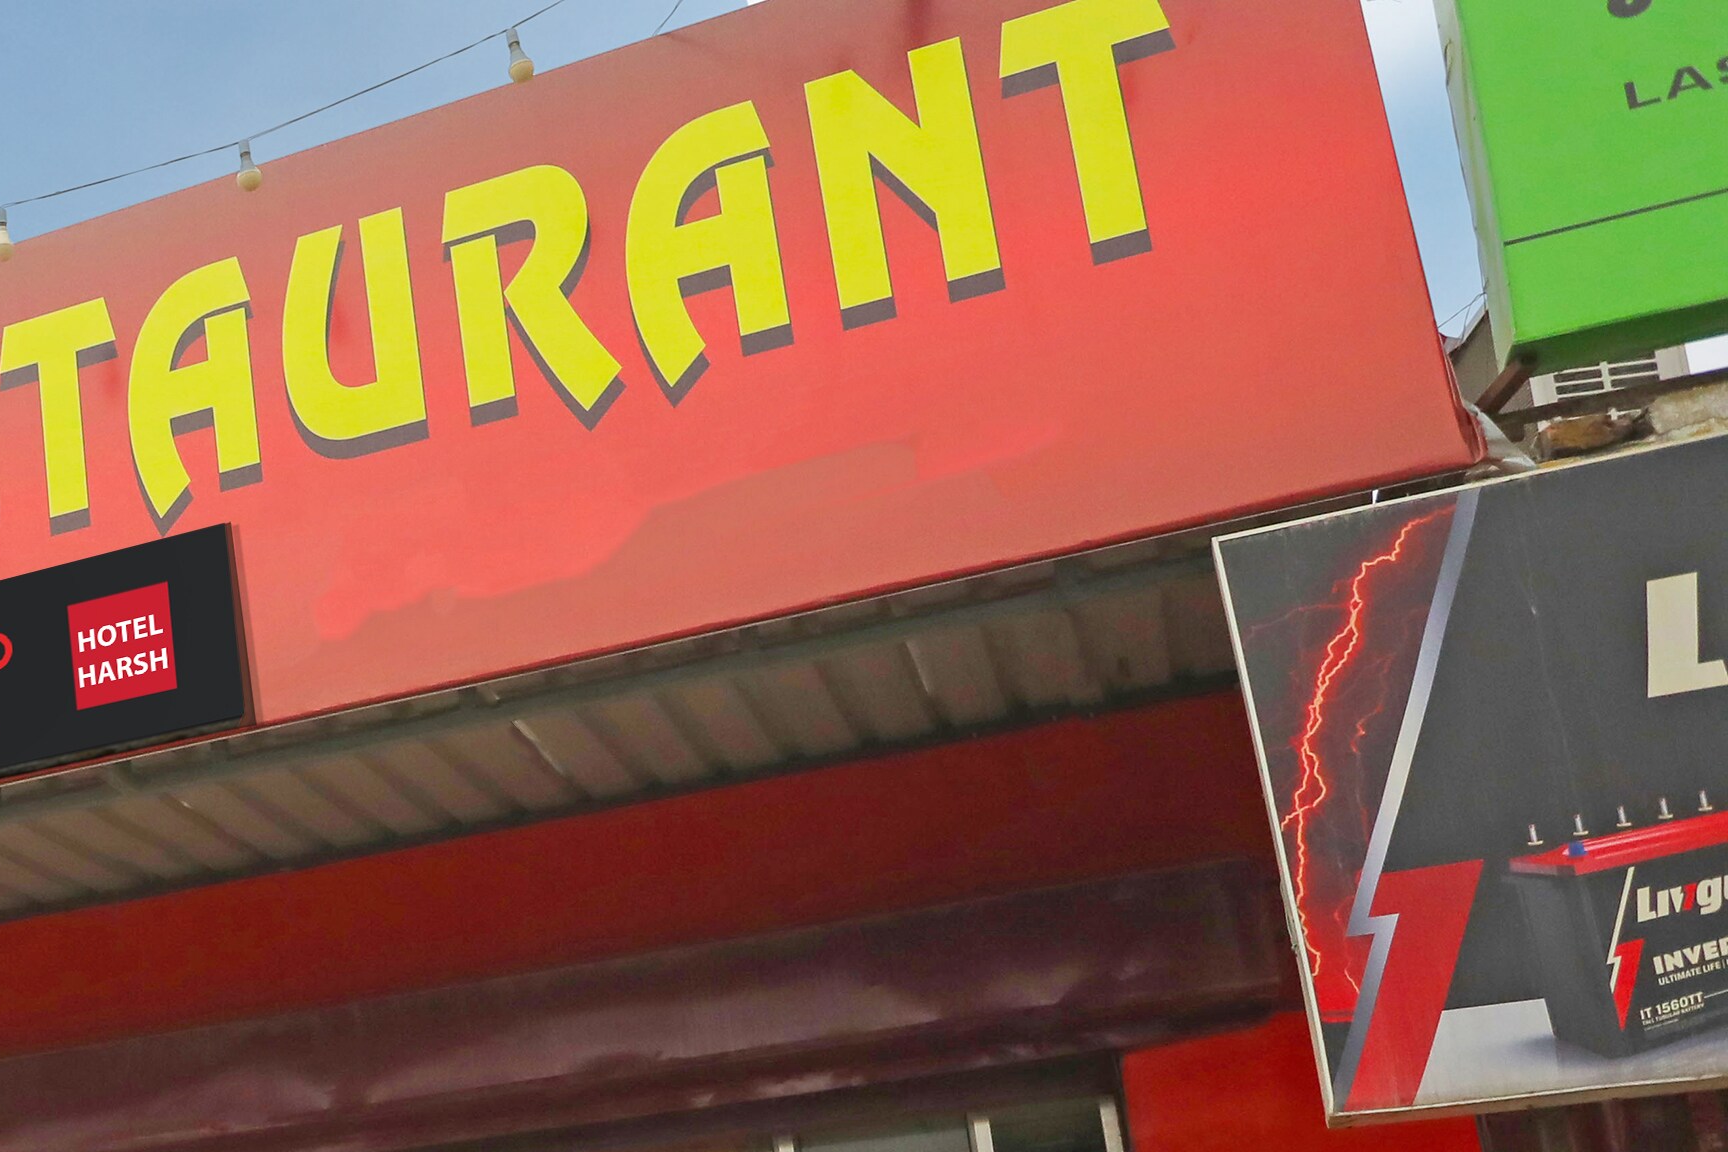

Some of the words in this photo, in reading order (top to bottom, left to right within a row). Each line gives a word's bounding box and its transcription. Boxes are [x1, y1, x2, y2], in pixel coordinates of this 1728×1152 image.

[76, 614, 164, 653] HOTEL
[76, 647, 170, 690] HARSH
[1658, 966, 1702, 986] ULTIMATE
[1702, 961, 1722, 973] LIFE
[1655, 991, 1704, 1015] 1560TT
